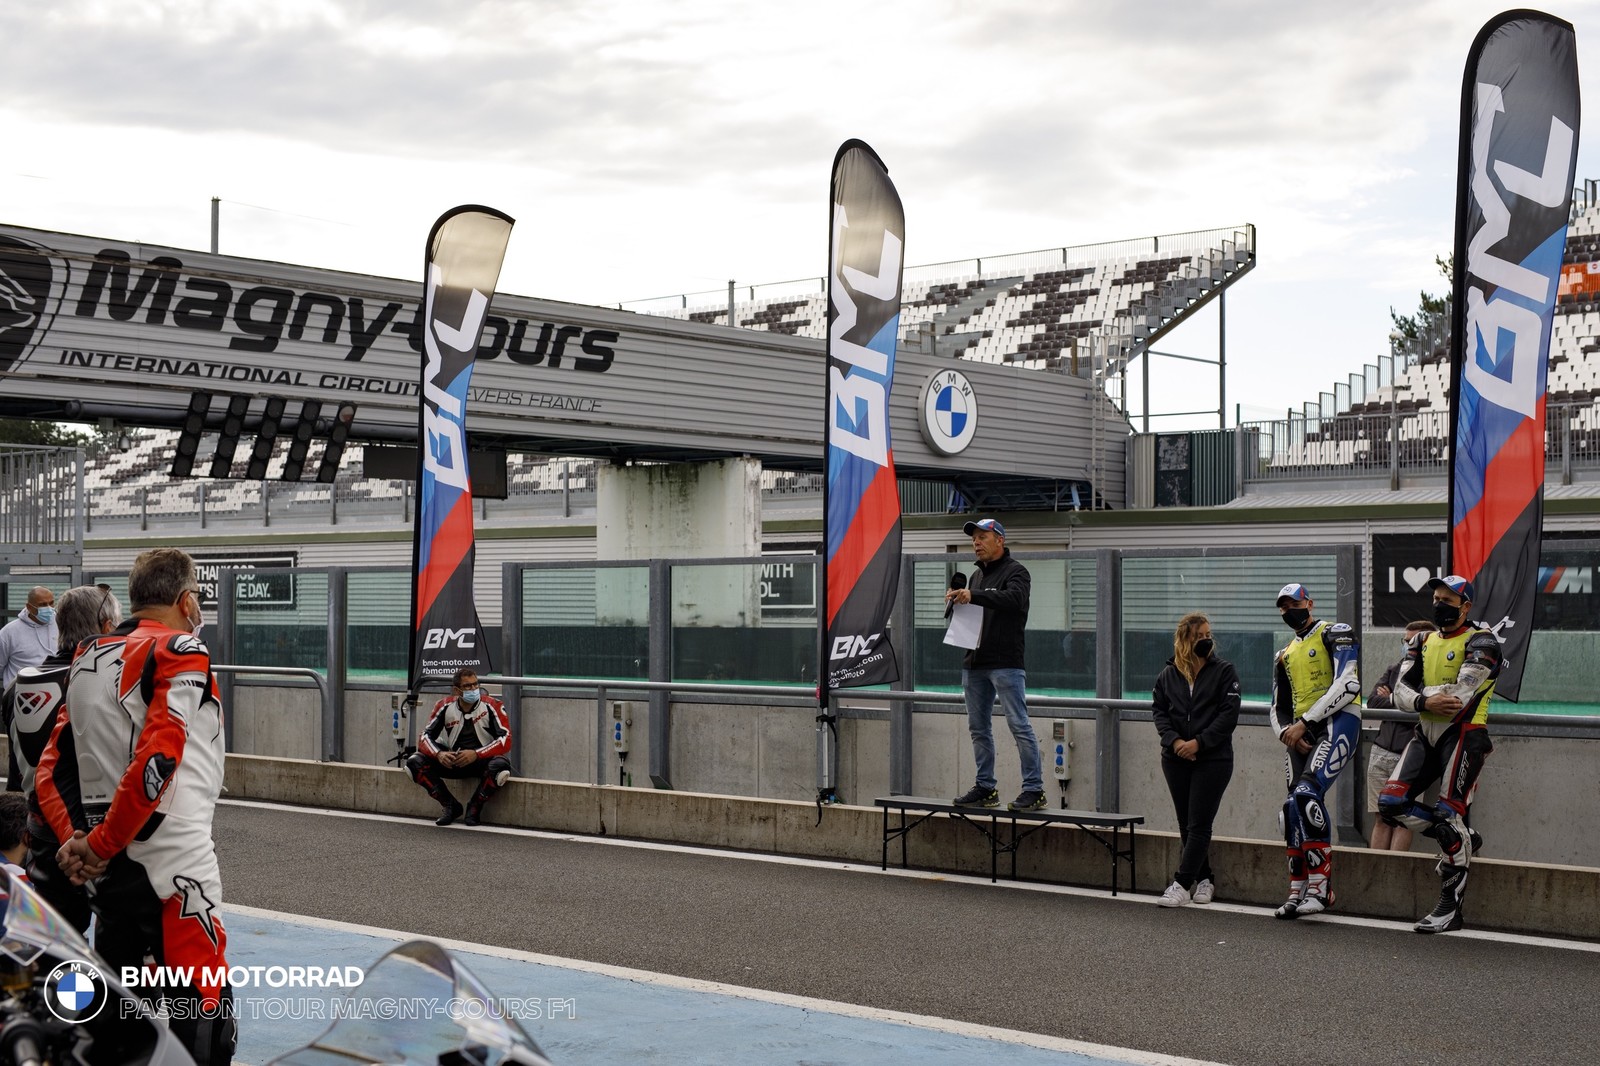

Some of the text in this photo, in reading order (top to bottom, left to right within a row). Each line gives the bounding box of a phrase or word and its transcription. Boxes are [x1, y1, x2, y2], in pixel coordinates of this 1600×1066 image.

[58, 350, 309, 386] INTERNATIONAL
[932, 372, 972, 397] BMW
[529, 394, 602, 412] FRANCE
[248, 582, 271, 598] DAY.
[422, 627, 476, 650] BMC
[829, 632, 881, 661] BMC
[422, 659, 481, 667] bmc-moto.com
[422, 667, 462, 675] #bmcmot
[1314, 739, 1333, 770] BMW
[1456, 750, 1470, 794] RST
